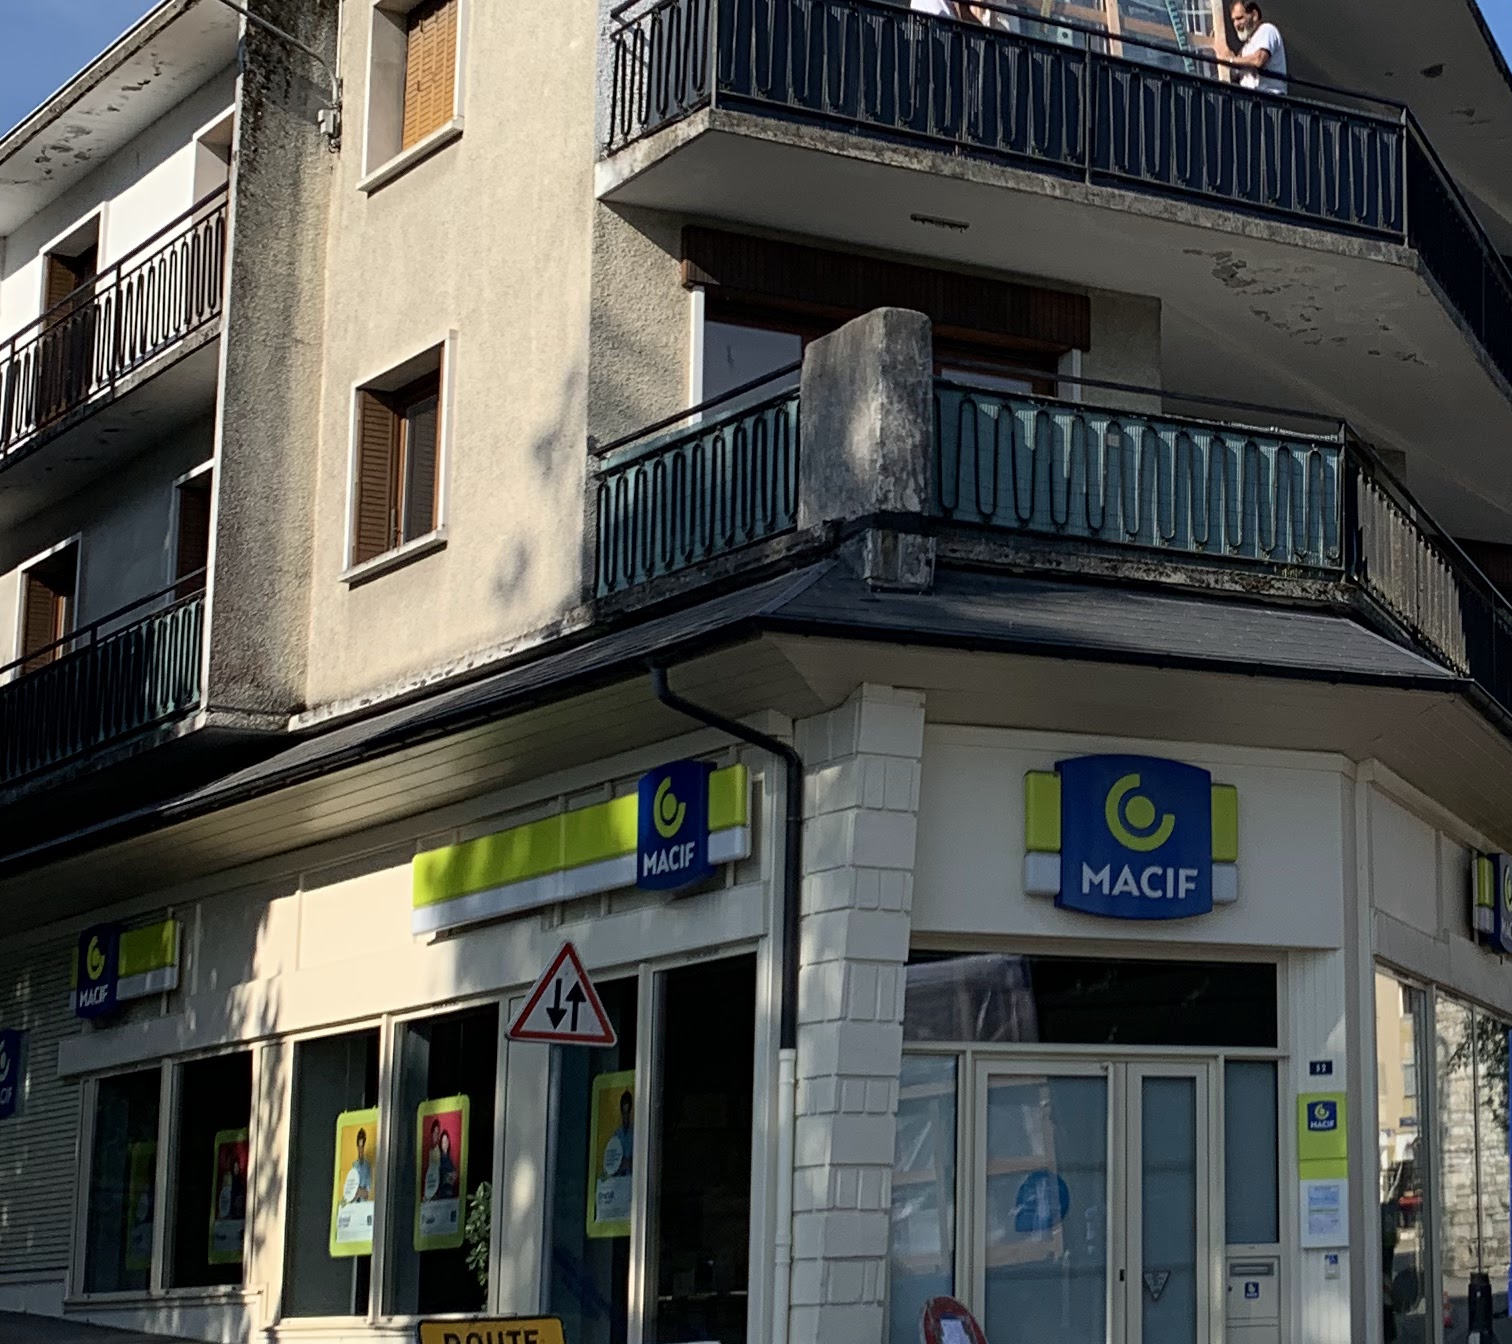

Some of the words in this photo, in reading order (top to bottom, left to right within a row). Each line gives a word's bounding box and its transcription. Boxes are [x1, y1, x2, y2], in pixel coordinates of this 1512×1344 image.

[642, 840, 695, 877] MACIF
[1081, 861, 1199, 899] MACIF
[79, 983, 109, 1008] MACIF
[1310, 1120, 1335, 1129] MACIF
